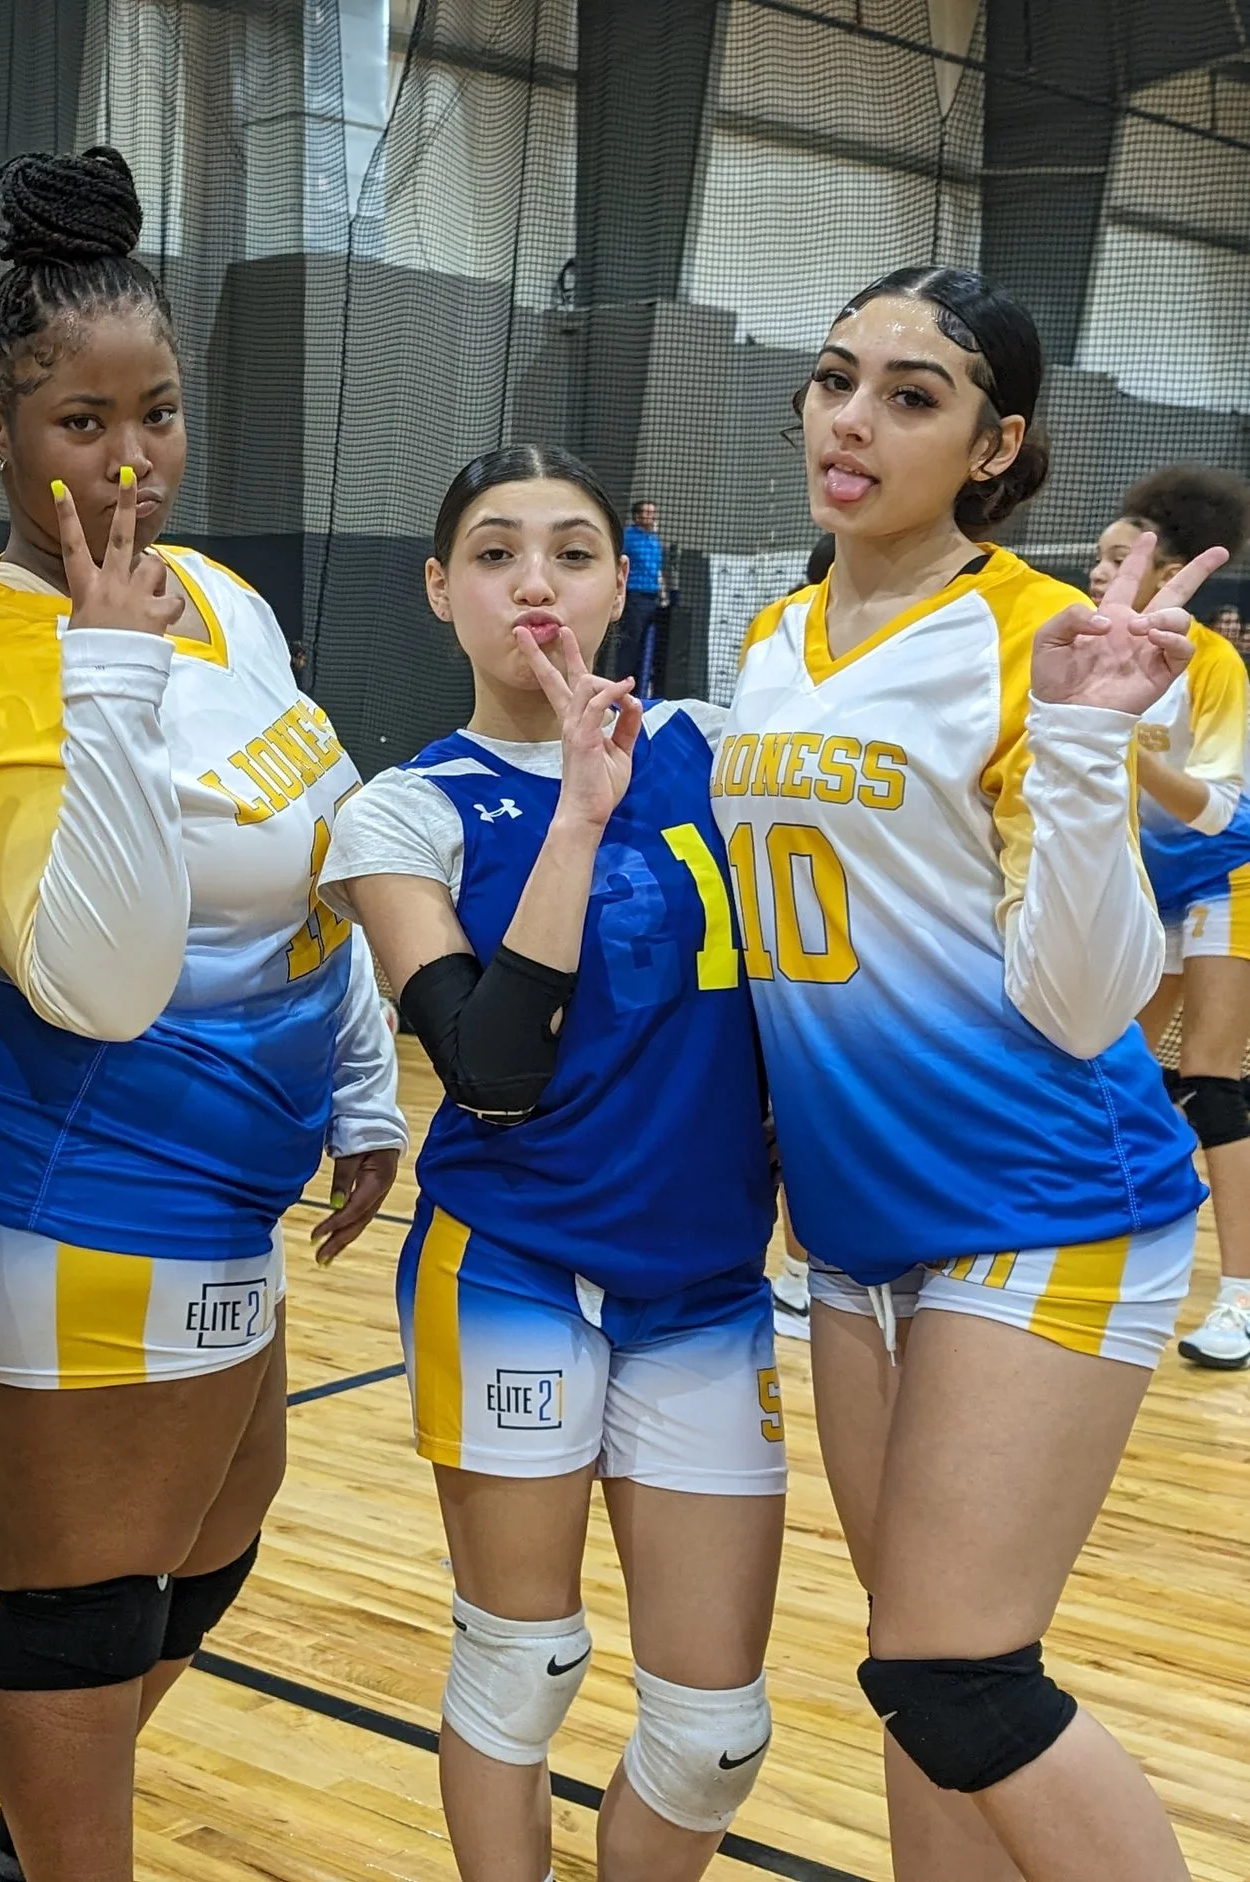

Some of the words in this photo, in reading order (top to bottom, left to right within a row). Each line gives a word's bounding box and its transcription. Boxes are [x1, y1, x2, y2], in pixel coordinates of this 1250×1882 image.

[710, 731, 908, 811] IONESS
[729, 822, 860, 985] 10
[185, 1300, 242, 1331] ELITE
[487, 1384, 532, 1414] ELITE
[539, 1380, 563, 1421] 21
